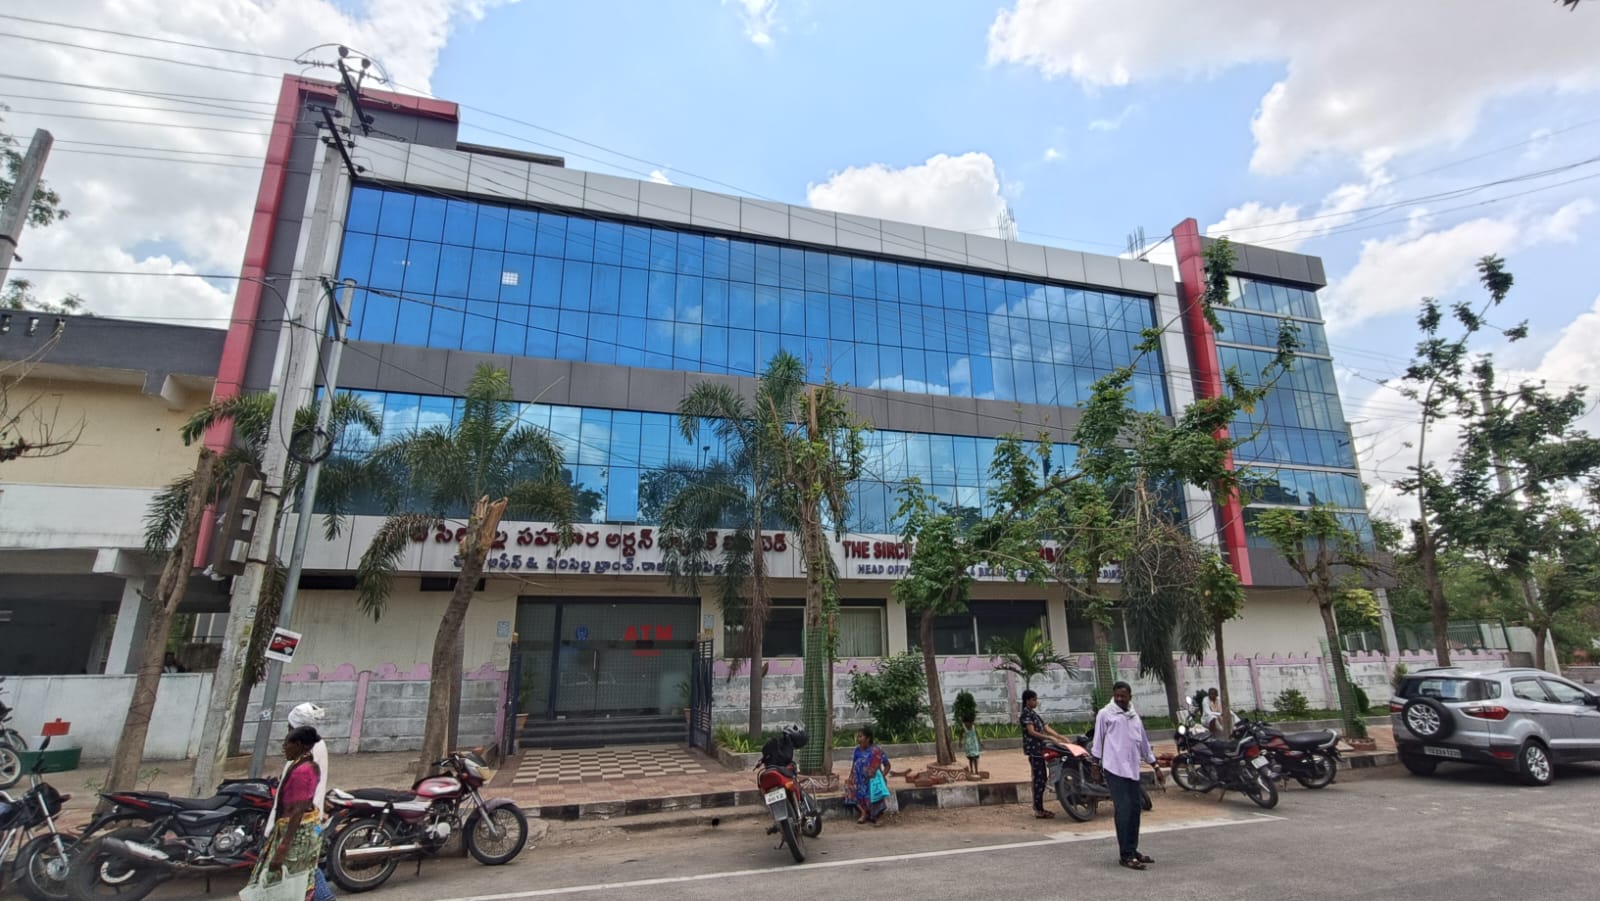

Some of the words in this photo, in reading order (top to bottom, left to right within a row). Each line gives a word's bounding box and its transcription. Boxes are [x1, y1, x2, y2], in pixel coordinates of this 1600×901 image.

[842, 540, 871, 559] THE
[873, 541, 915, 560] SIRCI
[857, 563, 884, 575] HEAD
[623, 623, 673, 641] ATM
